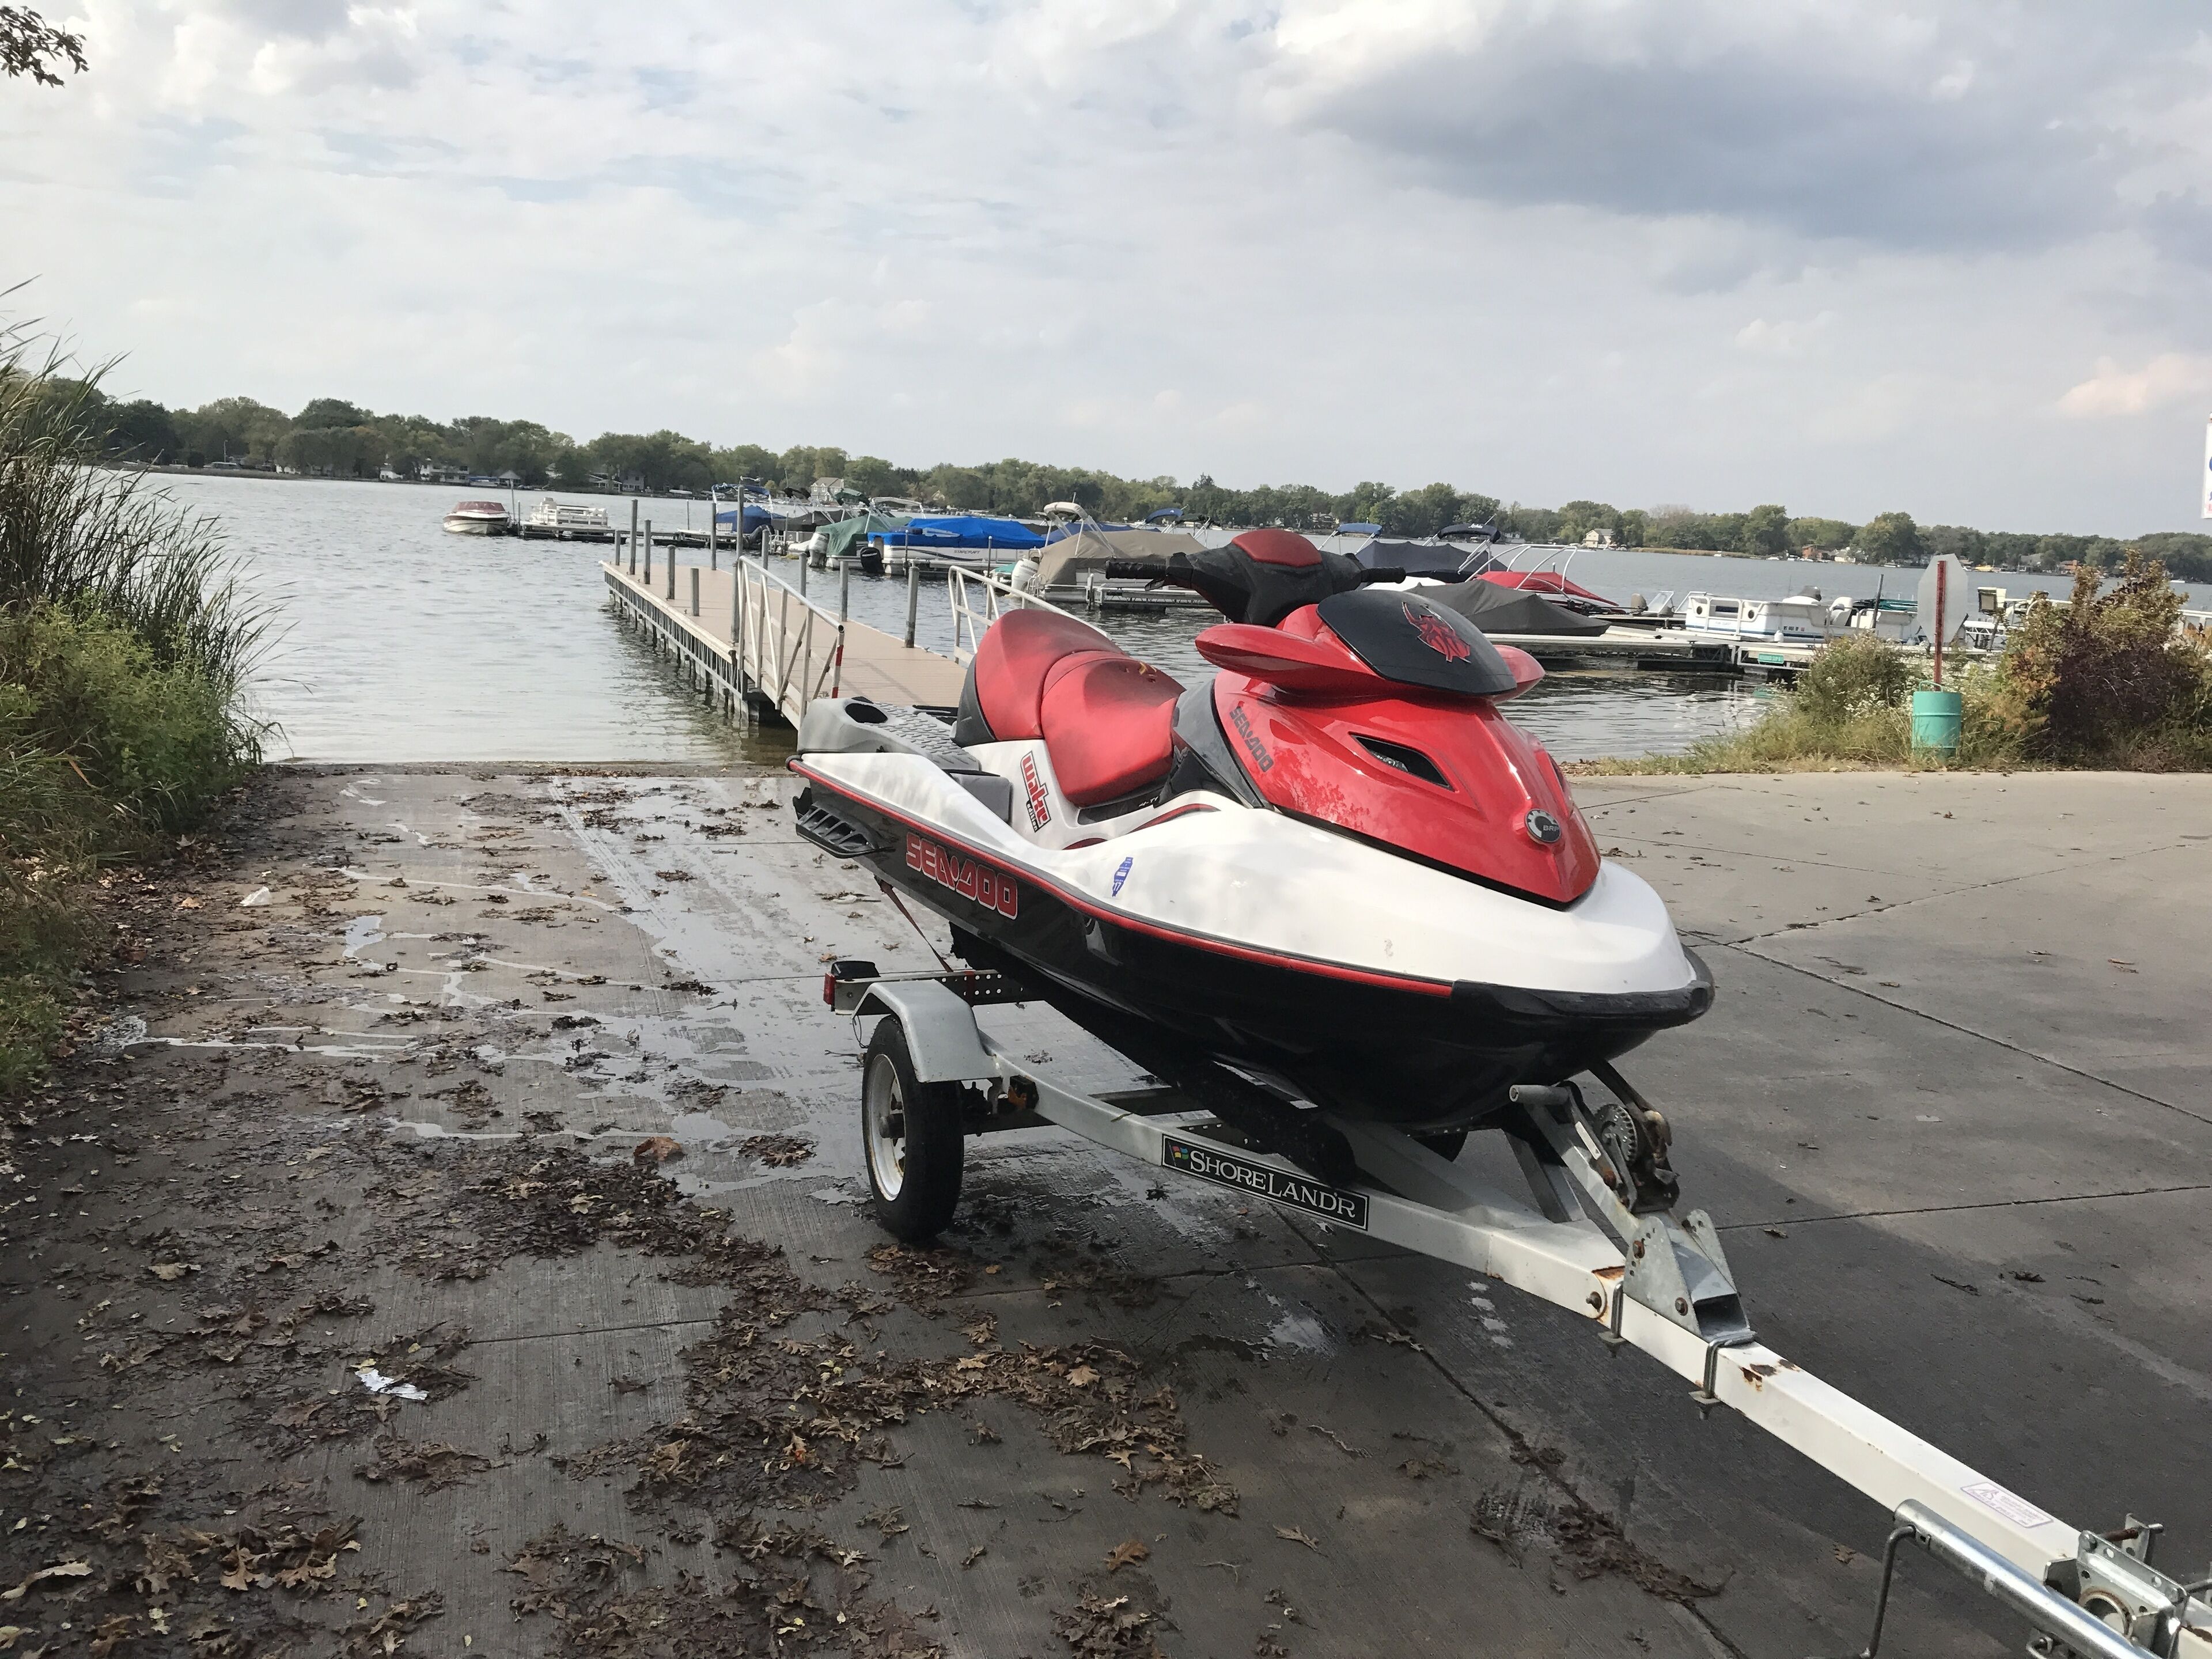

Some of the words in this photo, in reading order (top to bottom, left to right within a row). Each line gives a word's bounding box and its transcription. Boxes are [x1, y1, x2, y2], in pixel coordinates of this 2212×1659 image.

[1022, 755, 1048, 825] wake
[1027, 804, 1038, 831] edition
[1113, 882, 1122, 892] 17
